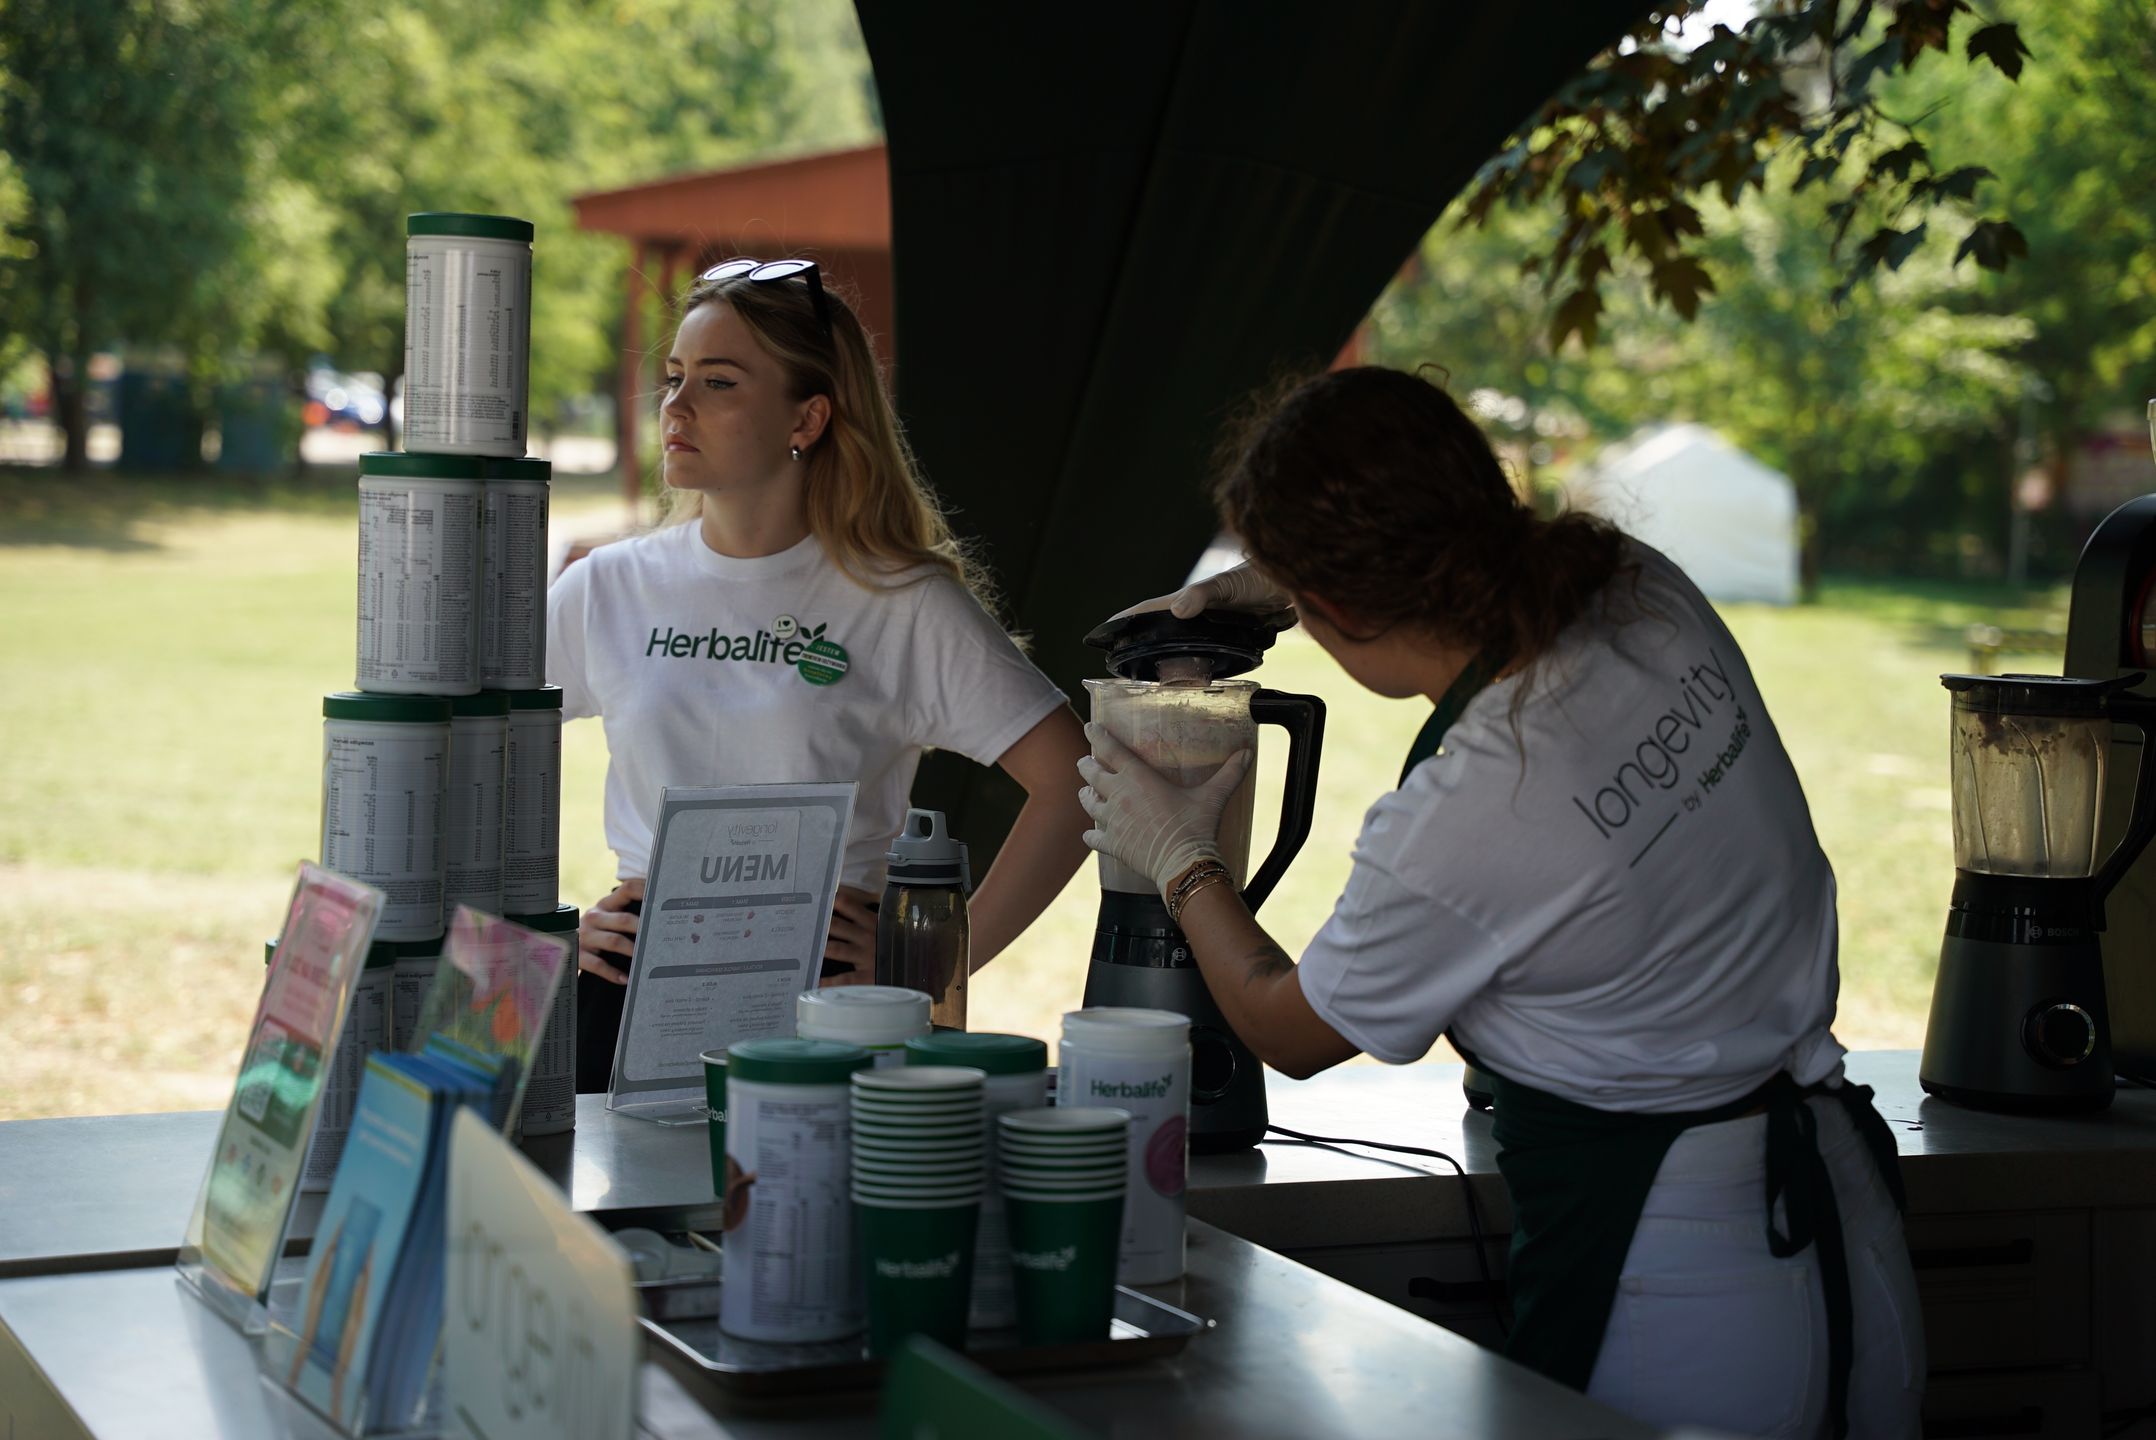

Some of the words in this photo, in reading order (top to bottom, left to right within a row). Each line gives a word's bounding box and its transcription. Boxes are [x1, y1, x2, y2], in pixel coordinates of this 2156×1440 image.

[646, 627, 805, 666] Herbalife
[1572, 647, 1737, 840] longevity
[1682, 790, 1702, 812] by
[1698, 719, 1751, 794] Herbalife
[2048, 928, 2079, 936] BOSCH
[1091, 1079, 1167, 1098] Herbalife
[875, 1258, 953, 1279] Herbalife
